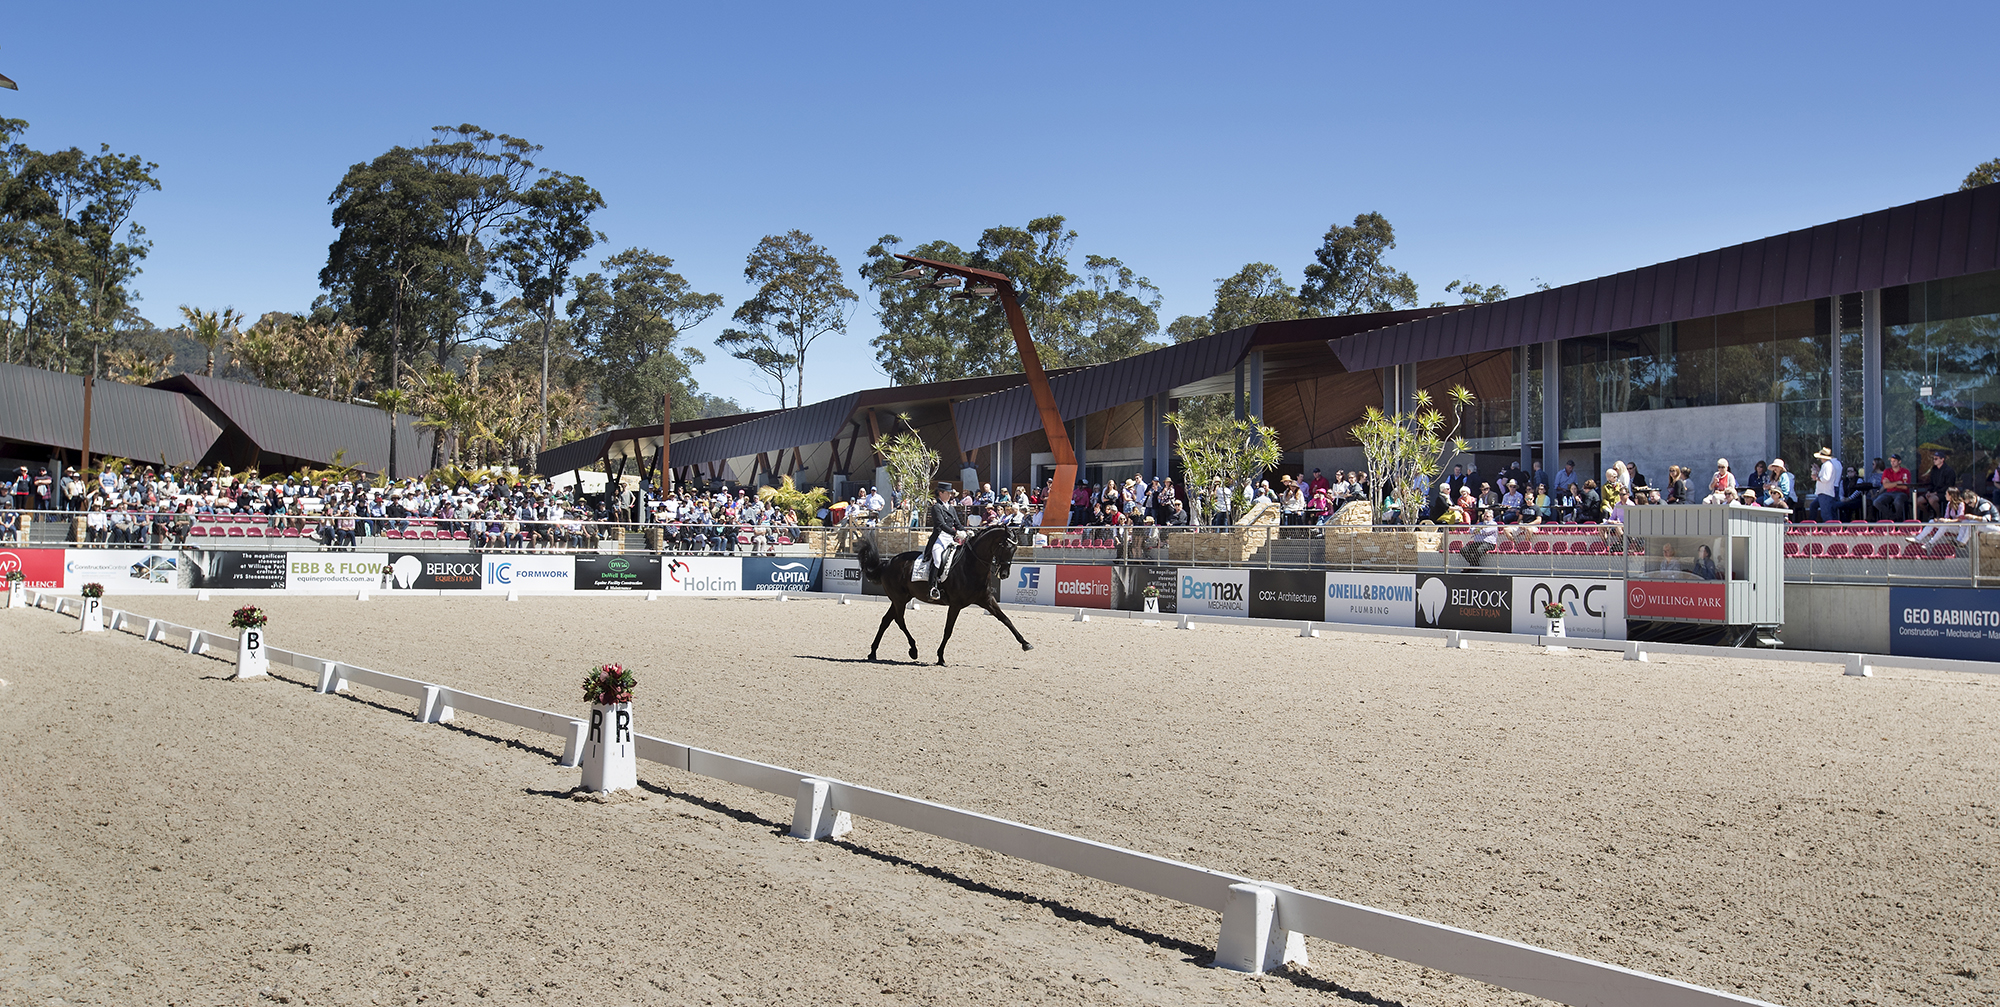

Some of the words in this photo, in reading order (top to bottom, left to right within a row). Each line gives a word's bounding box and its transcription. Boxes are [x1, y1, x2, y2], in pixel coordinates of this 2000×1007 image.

[291, 562, 319, 574] EBB
[324, 562, 335, 574] &
[340, 562, 381, 574] FLOW
[426, 563, 481, 576] BELROCK
[771, 571, 810, 583] CAPITAL
[15, 582, 21, 593] F
[684, 577, 736, 591] Holcim
[1182, 576, 1243, 601] Benmax
[1278, 592, 1317, 603] Architecture
[1452, 589, 1510, 611] BELROCK
[1648, 595, 1695, 606] WILLINGA
[1698, 597, 1722, 607] PARK
[91, 601, 98, 613] P
[1146, 600, 1155, 610] V
[1208, 601, 1244, 610] MECHANICAL
[1350, 605, 1389, 615] PLUMBING
[1459, 607, 1500, 618] EQUESTRIAN
[1903, 608, 1930, 624] GEO
[1552, 621, 1560, 633] E
[1899, 626, 1939, 637] Construction
[1946, 628, 1981, 639] Mechanical
[248, 632, 259, 650] B
[590, 709, 603, 743] R
[616, 711, 630, 743] R
